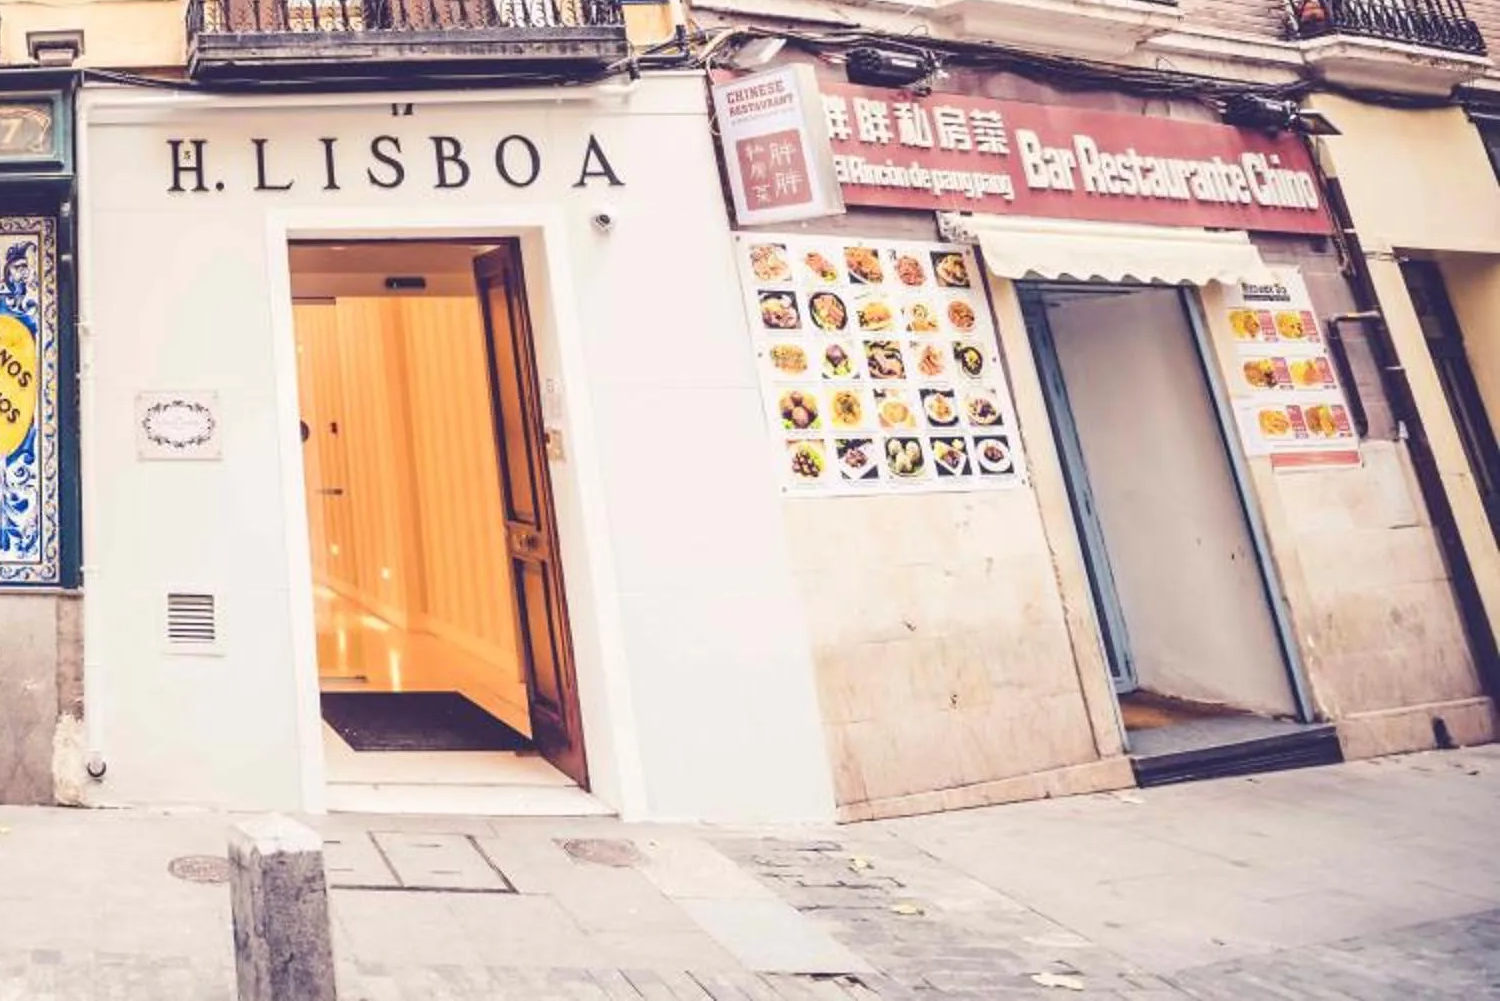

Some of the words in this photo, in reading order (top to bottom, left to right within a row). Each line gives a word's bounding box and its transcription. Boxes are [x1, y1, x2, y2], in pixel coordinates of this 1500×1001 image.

[726, 80, 785, 104] CHINESE
[729, 93, 794, 118] RESTAURANT
[166, 139, 225, 192] H.
[251, 134, 626, 192] LISBOA
[1016, 129, 1076, 190] Bar
[1072, 133, 1250, 204] Restaurante
[1241, 152, 1319, 211] Chino
